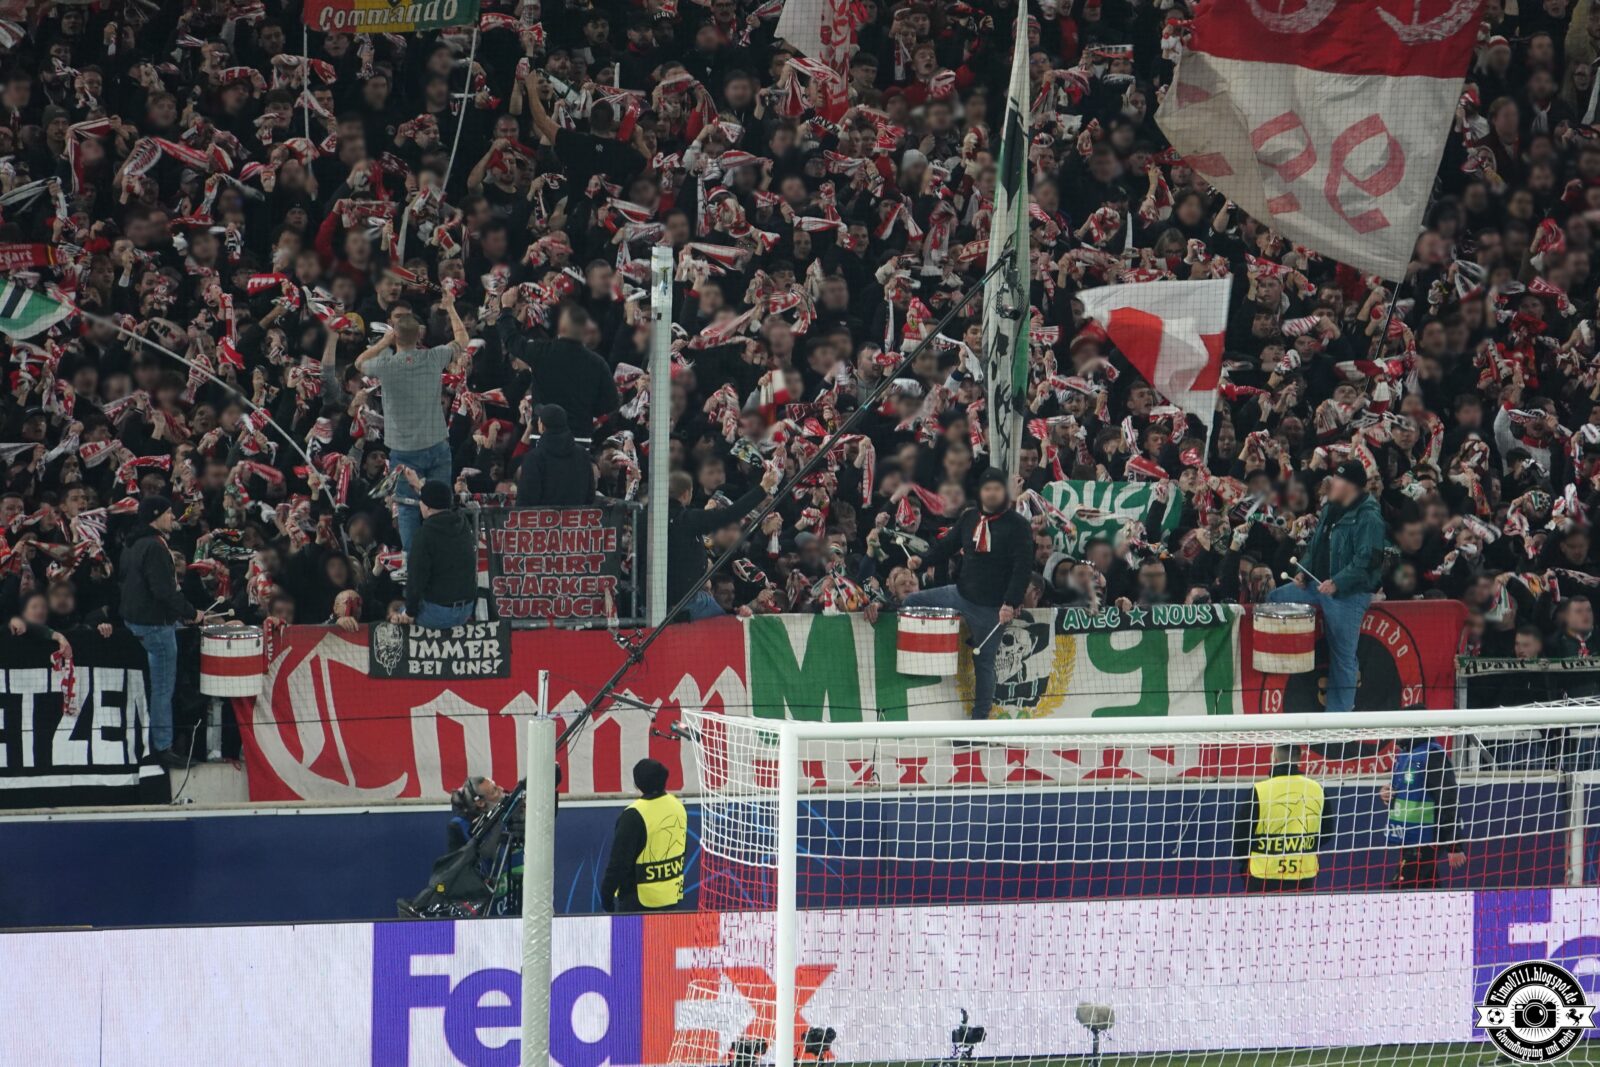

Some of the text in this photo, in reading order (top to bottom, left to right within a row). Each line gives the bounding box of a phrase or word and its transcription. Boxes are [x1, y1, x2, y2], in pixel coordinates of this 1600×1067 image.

[318, 0, 458, 31] Commando
[504, 509, 603, 529] JEDER
[490, 527, 617, 554] VERBANNTE
[502, 553, 605, 574] KEHRT
[492, 575, 617, 597] STÄRKER
[496, 596, 613, 617] ZURÜCK
[1063, 604, 1213, 630] AVEC NOUS
[451, 621, 500, 639] BIST
[408, 639, 501, 659] IMMER
[408, 659, 503, 675] BEI UNS!
[1264, 689, 1282, 713] 19
[0, 666, 150, 767] TZEN
[645, 857, 684, 881] STEW
